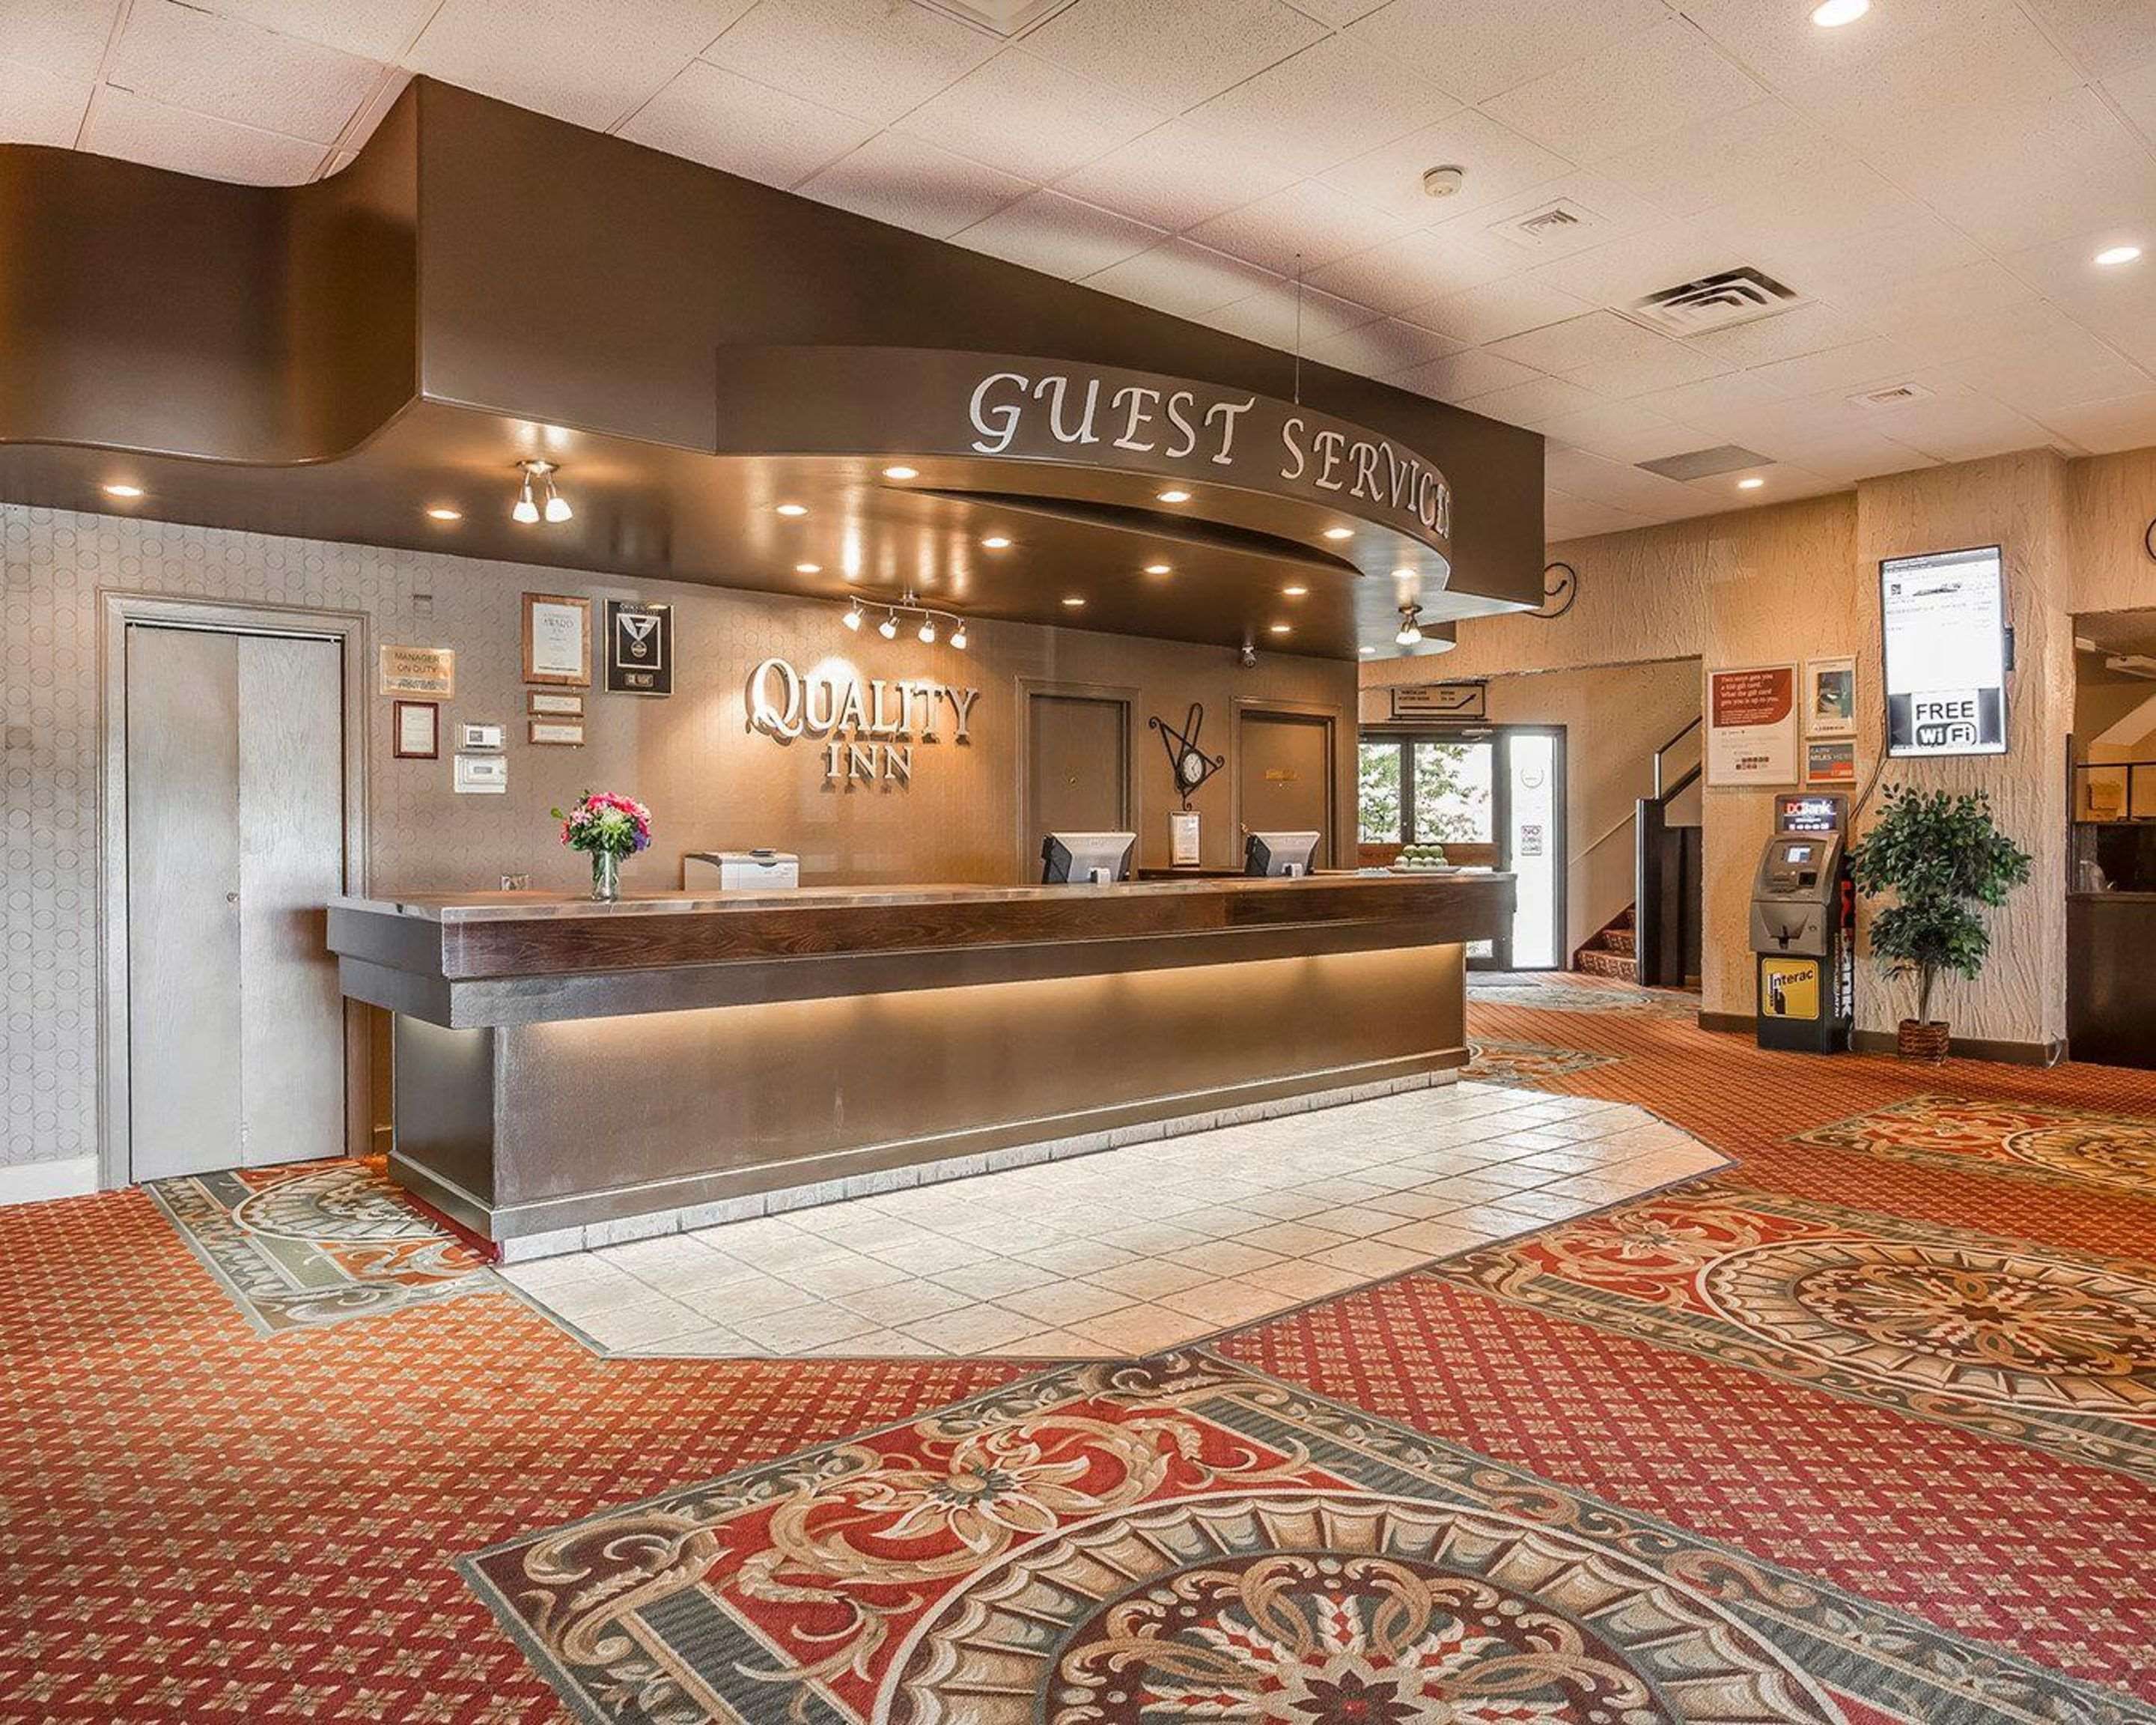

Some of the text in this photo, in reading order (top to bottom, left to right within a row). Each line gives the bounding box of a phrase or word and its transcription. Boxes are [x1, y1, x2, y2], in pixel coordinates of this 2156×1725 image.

[969, 373, 1255, 465] GUEST
[395, 653, 439, 663] MANAGER
[398, 664, 436, 673] ON DUTY
[751, 657, 979, 738] QUALITY
[1916, 701, 1974, 720] FREE
[826, 741, 913, 779] INN
